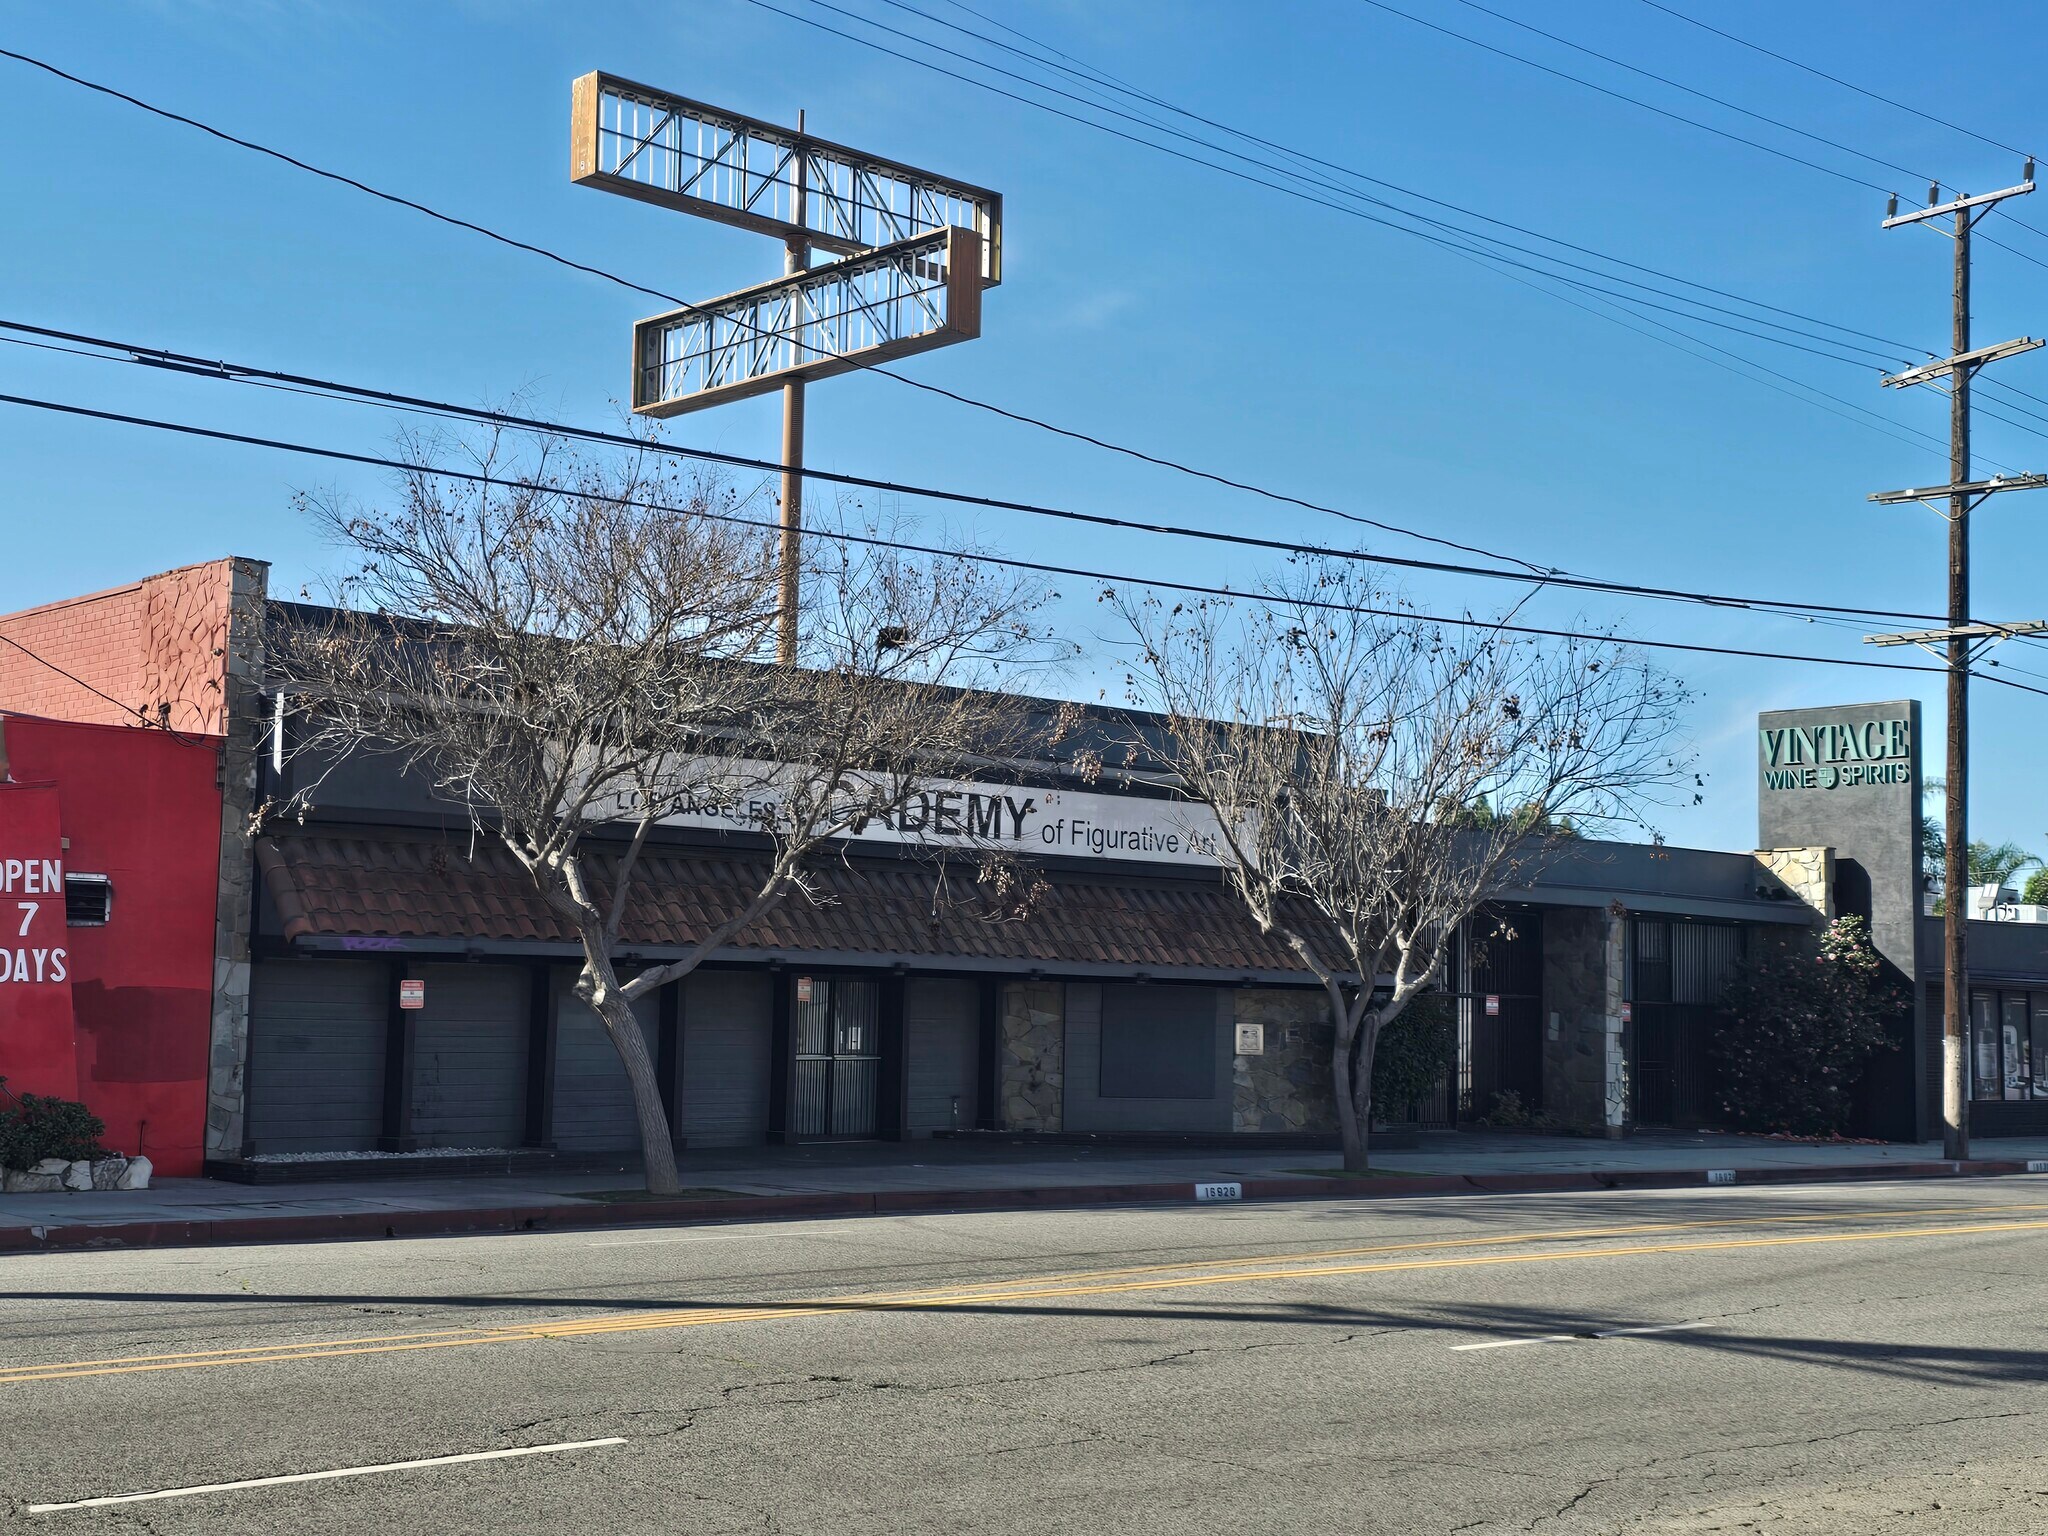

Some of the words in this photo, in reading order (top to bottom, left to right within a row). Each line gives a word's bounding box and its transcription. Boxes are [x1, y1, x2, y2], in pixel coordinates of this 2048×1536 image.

[1759, 719, 1909, 767] VINTAGE
[1763, 767, 1817, 790] WINE
[1841, 762, 1910, 786] SPIRITS
[1042, 819, 1064, 844] of
[1072, 820, 1179, 854] Figurative
[1186, 831, 1216, 856] Art
[18, 902, 39, 936] 7
